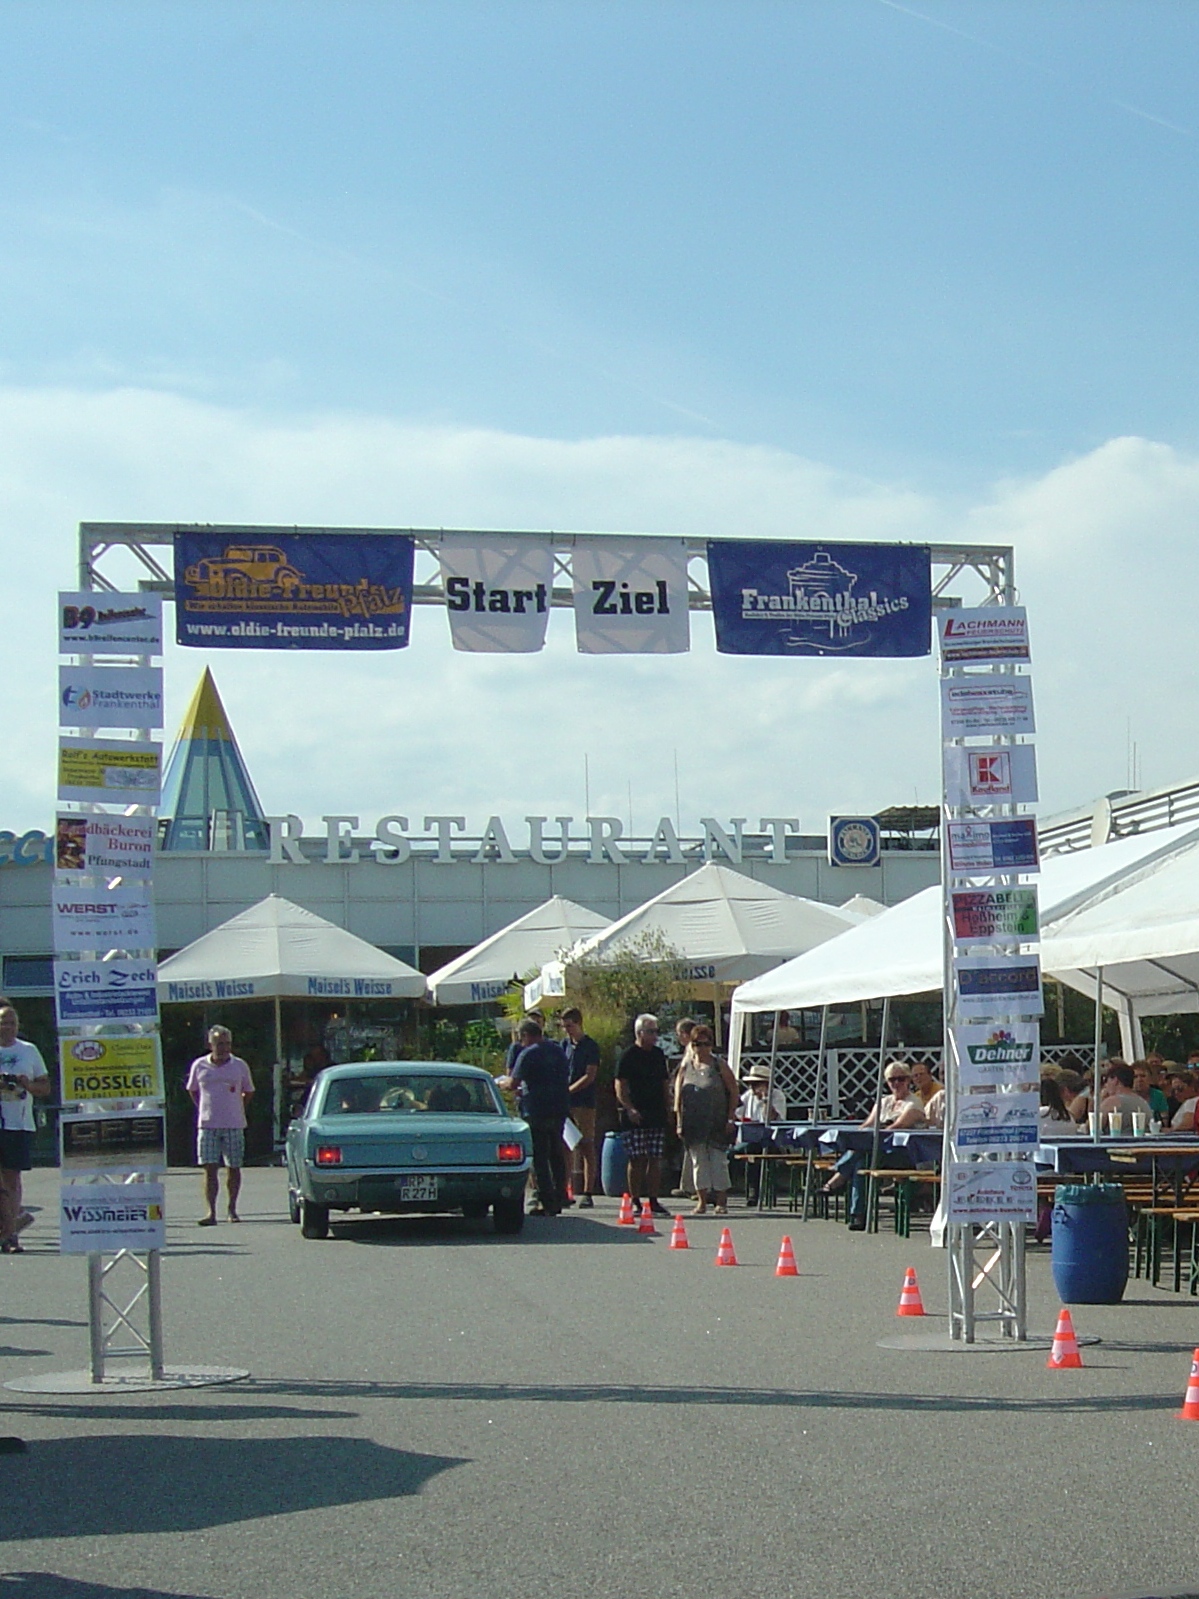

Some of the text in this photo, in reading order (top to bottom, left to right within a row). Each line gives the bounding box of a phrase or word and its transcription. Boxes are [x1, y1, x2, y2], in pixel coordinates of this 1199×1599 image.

[338, 585, 403, 618] Pfalz
[447, 577, 546, 613] Start
[592, 580, 670, 614] Ziel
[741, 588, 877, 612] Frankenthal
[837, 596, 909, 626] Classics
[186, 621, 405, 640] www.oldie-freunde-pfalz.de
[944, 619, 1025, 636] LACHMANN
[92, 690, 161, 700] Stadtwerke
[92, 700, 160, 709] Frankenthal
[108, 838, 151, 852] Buron
[265, 814, 799, 864] RESTAURANT
[88, 855, 151, 869] Pfungstadt
[57, 904, 117, 913] WERST
[970, 922, 1025, 936] Eppstein
[59, 969, 155, 989] Erich Zech
[308, 977, 392, 995] Maisel's Weisse
[168, 982, 213, 1001] Maisel's
[215, 980, 254, 998] Weisse
[975, 1047, 1030, 1061] Dehner
[74, 1073, 152, 1092] RÖSSLER
